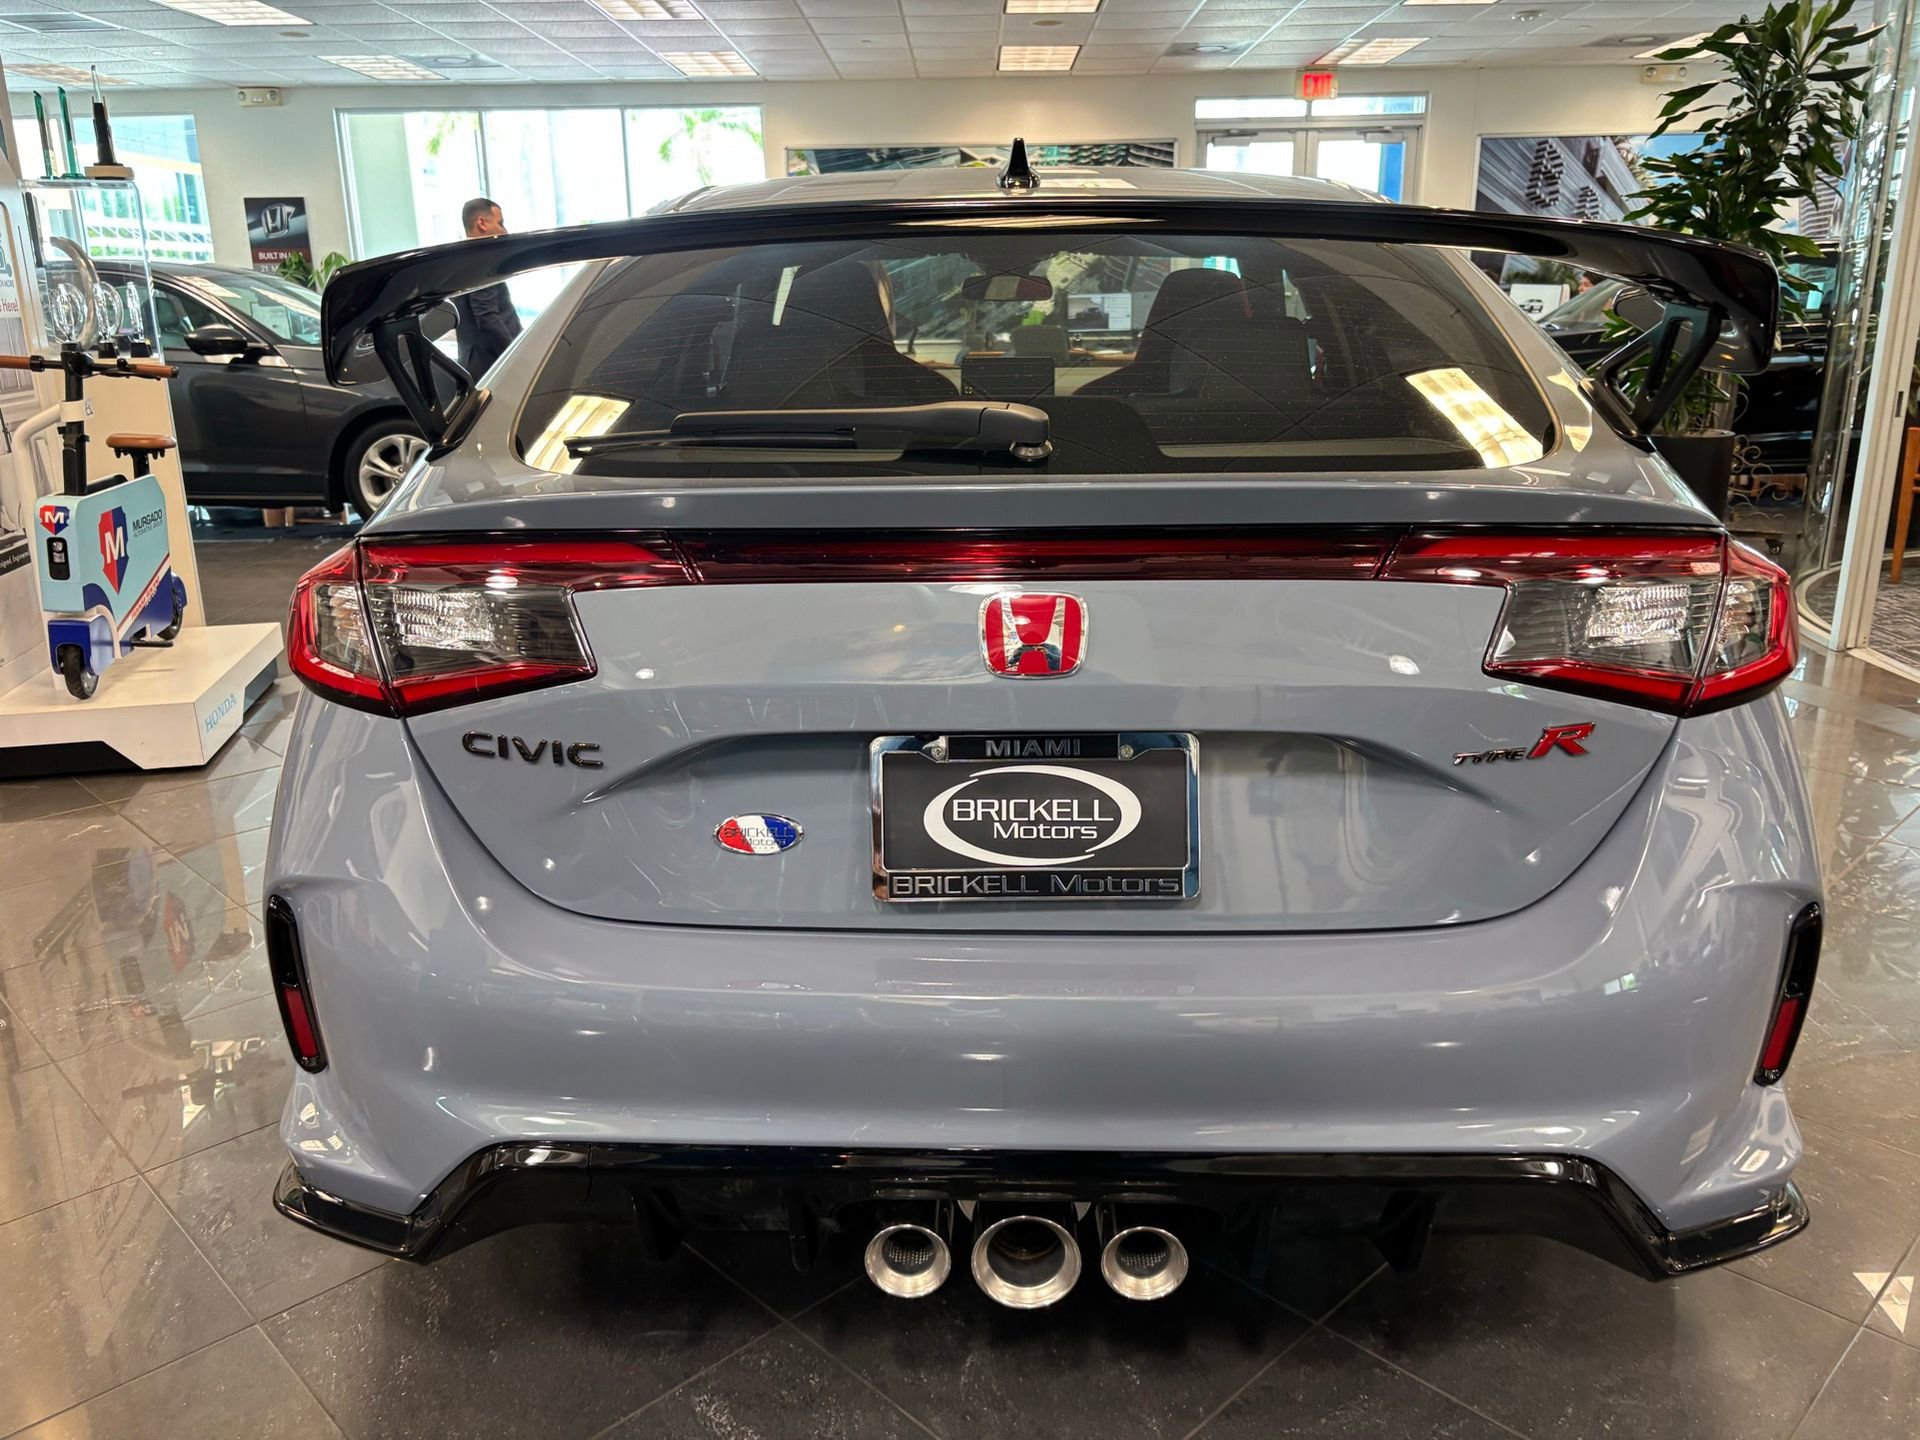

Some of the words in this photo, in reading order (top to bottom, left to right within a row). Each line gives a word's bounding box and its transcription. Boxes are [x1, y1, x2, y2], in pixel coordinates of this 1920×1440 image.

[1303, 73, 1332, 97] EXIT
[258, 252, 278, 260] BUILT
[44, 511, 65, 524] M
[132, 508, 163, 532] MURGADO
[104, 526, 125, 565] M
[204, 693, 237, 734] HONDA
[462, 730, 604, 768] CIVIC
[985, 739, 1081, 757] MIAMI
[1453, 747, 1528, 765] TYPE
[1526, 721, 1596, 760] R
[952, 799, 1114, 821] BRICKELL
[724, 827, 795, 838] BRICKELL
[993, 822, 1098, 839] Motors
[892, 876, 1039, 895] BRICKELL
[1050, 874, 1180, 893] Motors
